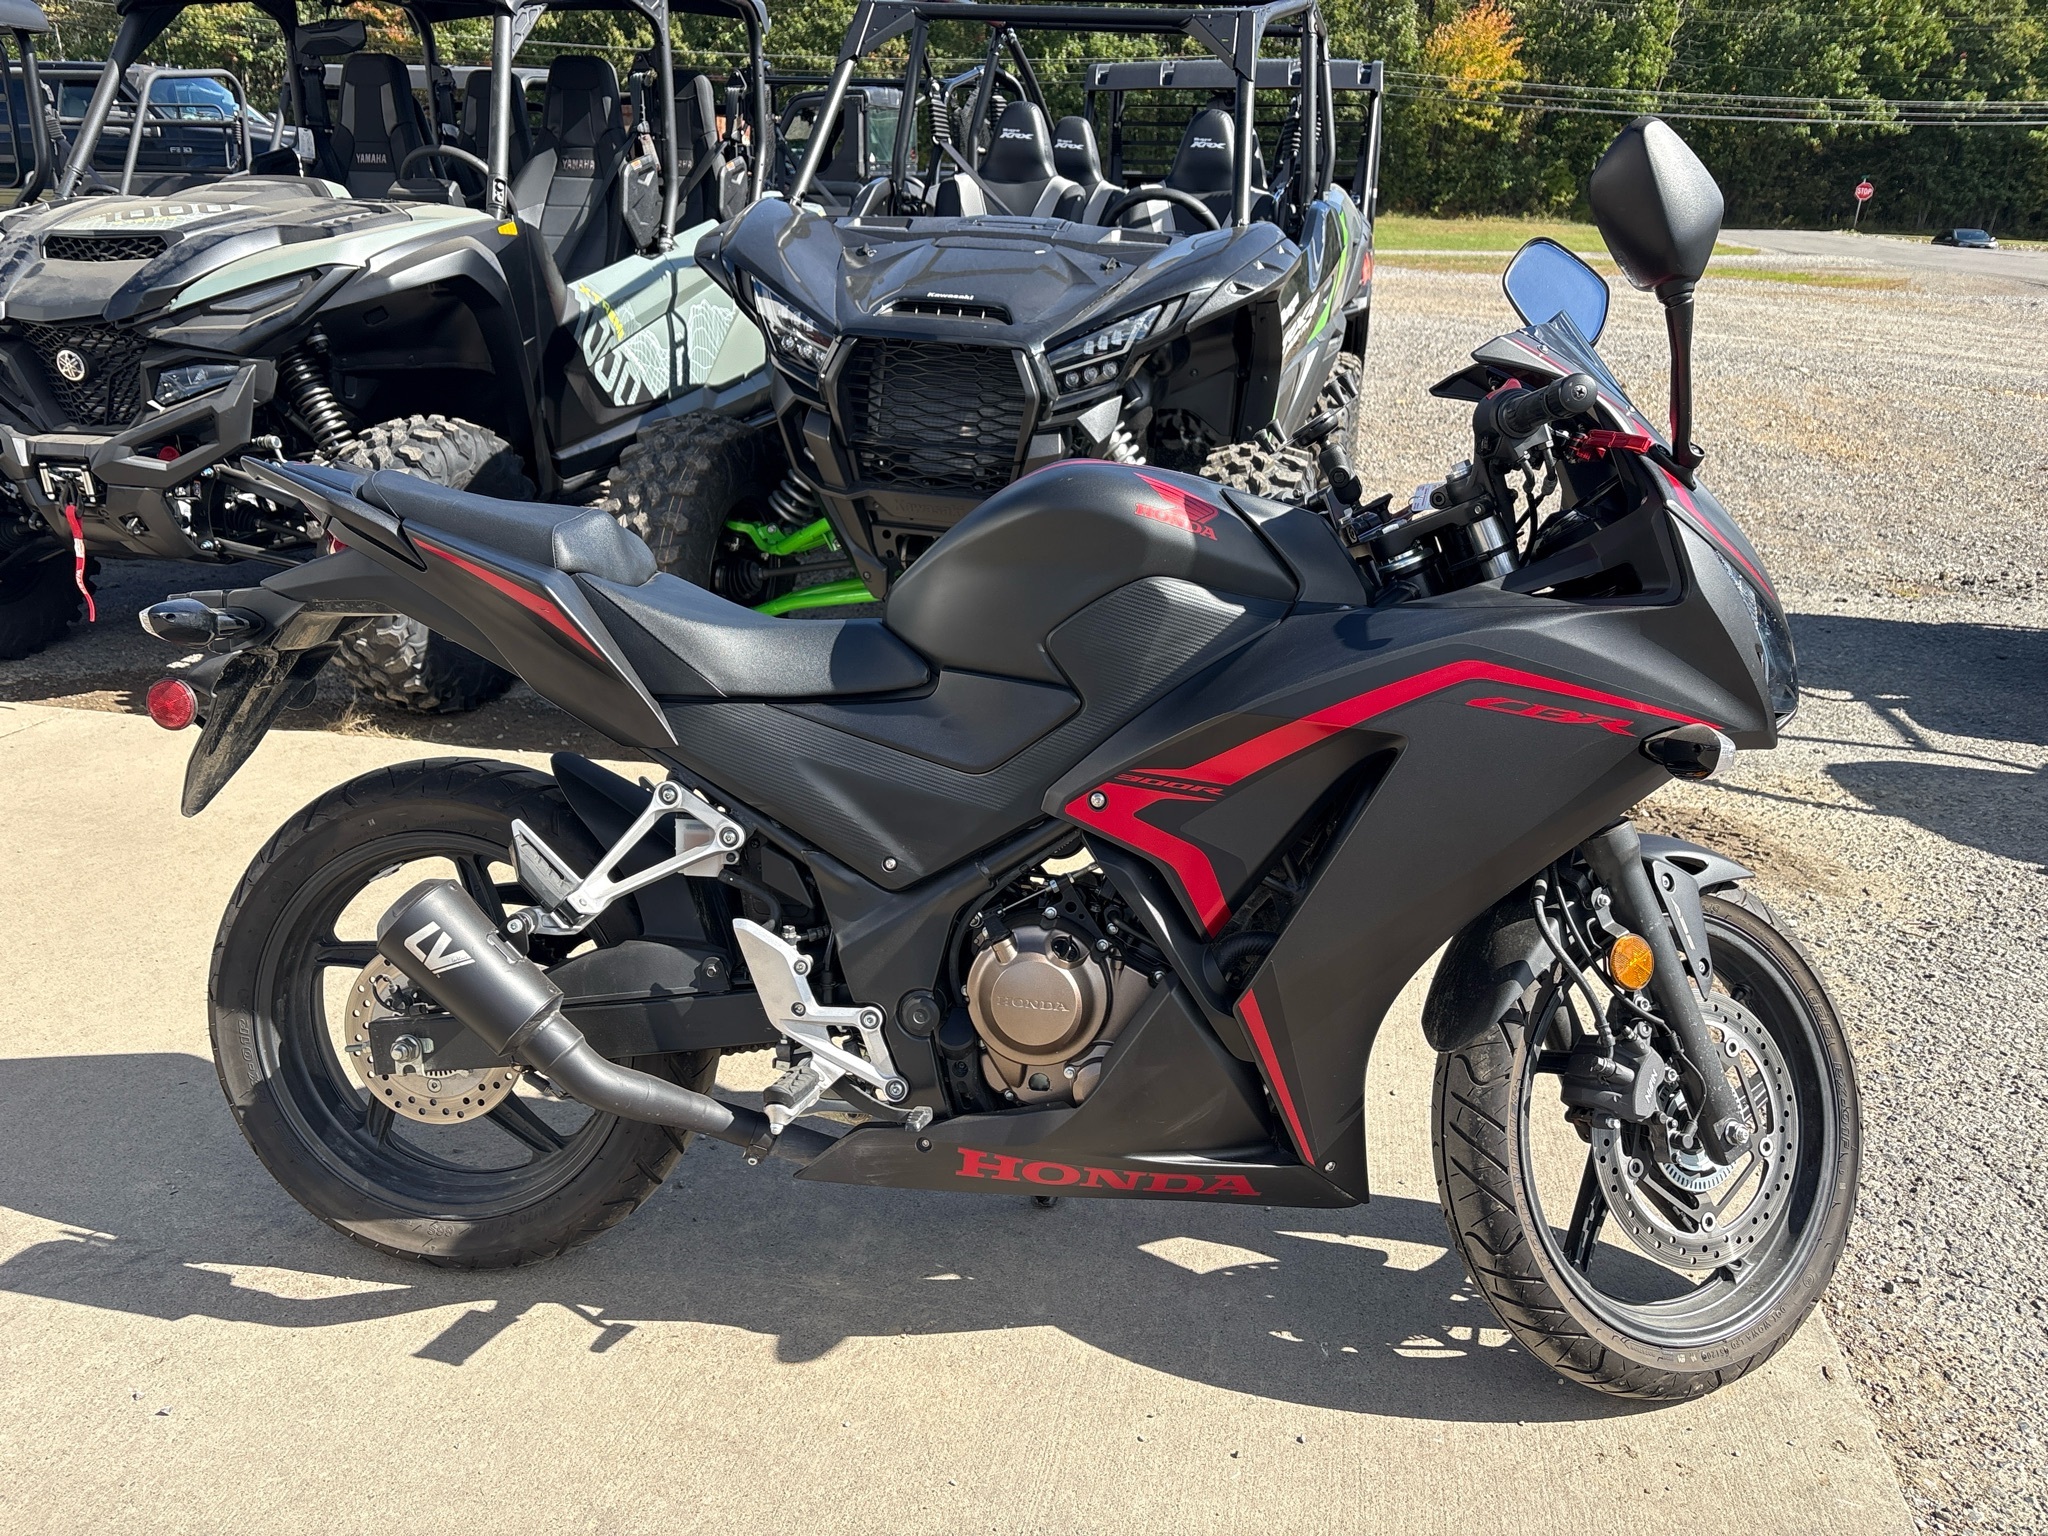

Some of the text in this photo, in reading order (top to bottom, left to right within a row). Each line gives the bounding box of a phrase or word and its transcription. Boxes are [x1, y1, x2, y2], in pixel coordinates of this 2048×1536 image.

[1000, 132, 1034, 140] KRX
[1190, 141, 1226, 149] KRX
[356, 153, 387, 164] YAMAHA
[562, 159, 595, 170] YAMAHA
[1857, 187, 1871, 195] STOP
[927, 292, 974, 301] Kawasaki
[1135, 502, 1218, 541] HONDA
[1465, 697, 1638, 737] CBR
[1114, 773, 1225, 796] 300R
[403, 920, 475, 975] LV
[997, 996, 1070, 1012] HONDA
[955, 1147, 1262, 1197] HONDA
